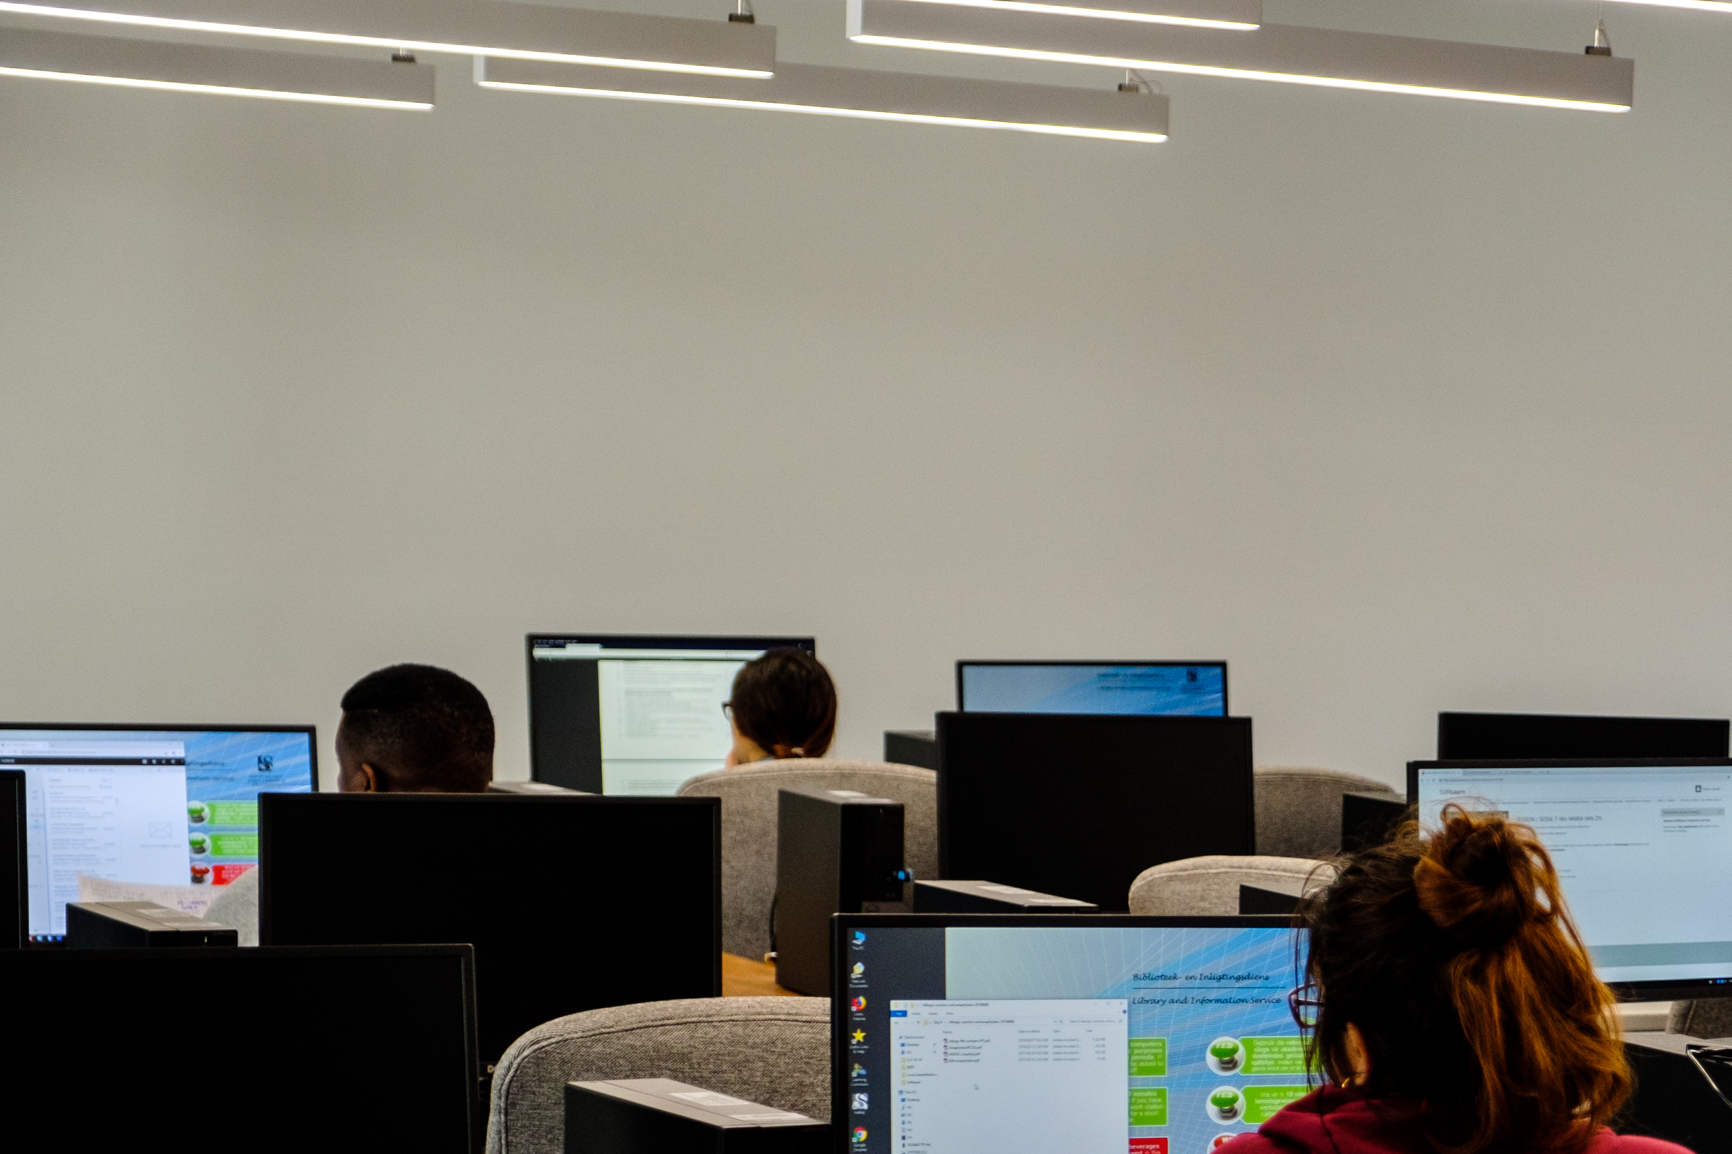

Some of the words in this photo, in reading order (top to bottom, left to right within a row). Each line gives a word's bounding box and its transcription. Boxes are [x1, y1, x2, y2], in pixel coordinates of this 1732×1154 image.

[1132, 972, 1182, 982] Biblioteek-
[1198, 972, 1270, 983] Inligtingsdiens
[1132, 996, 1166, 1006] Library
[1190, 996, 1249, 1006] Information
[1250, 996, 1282, 1004] Service
